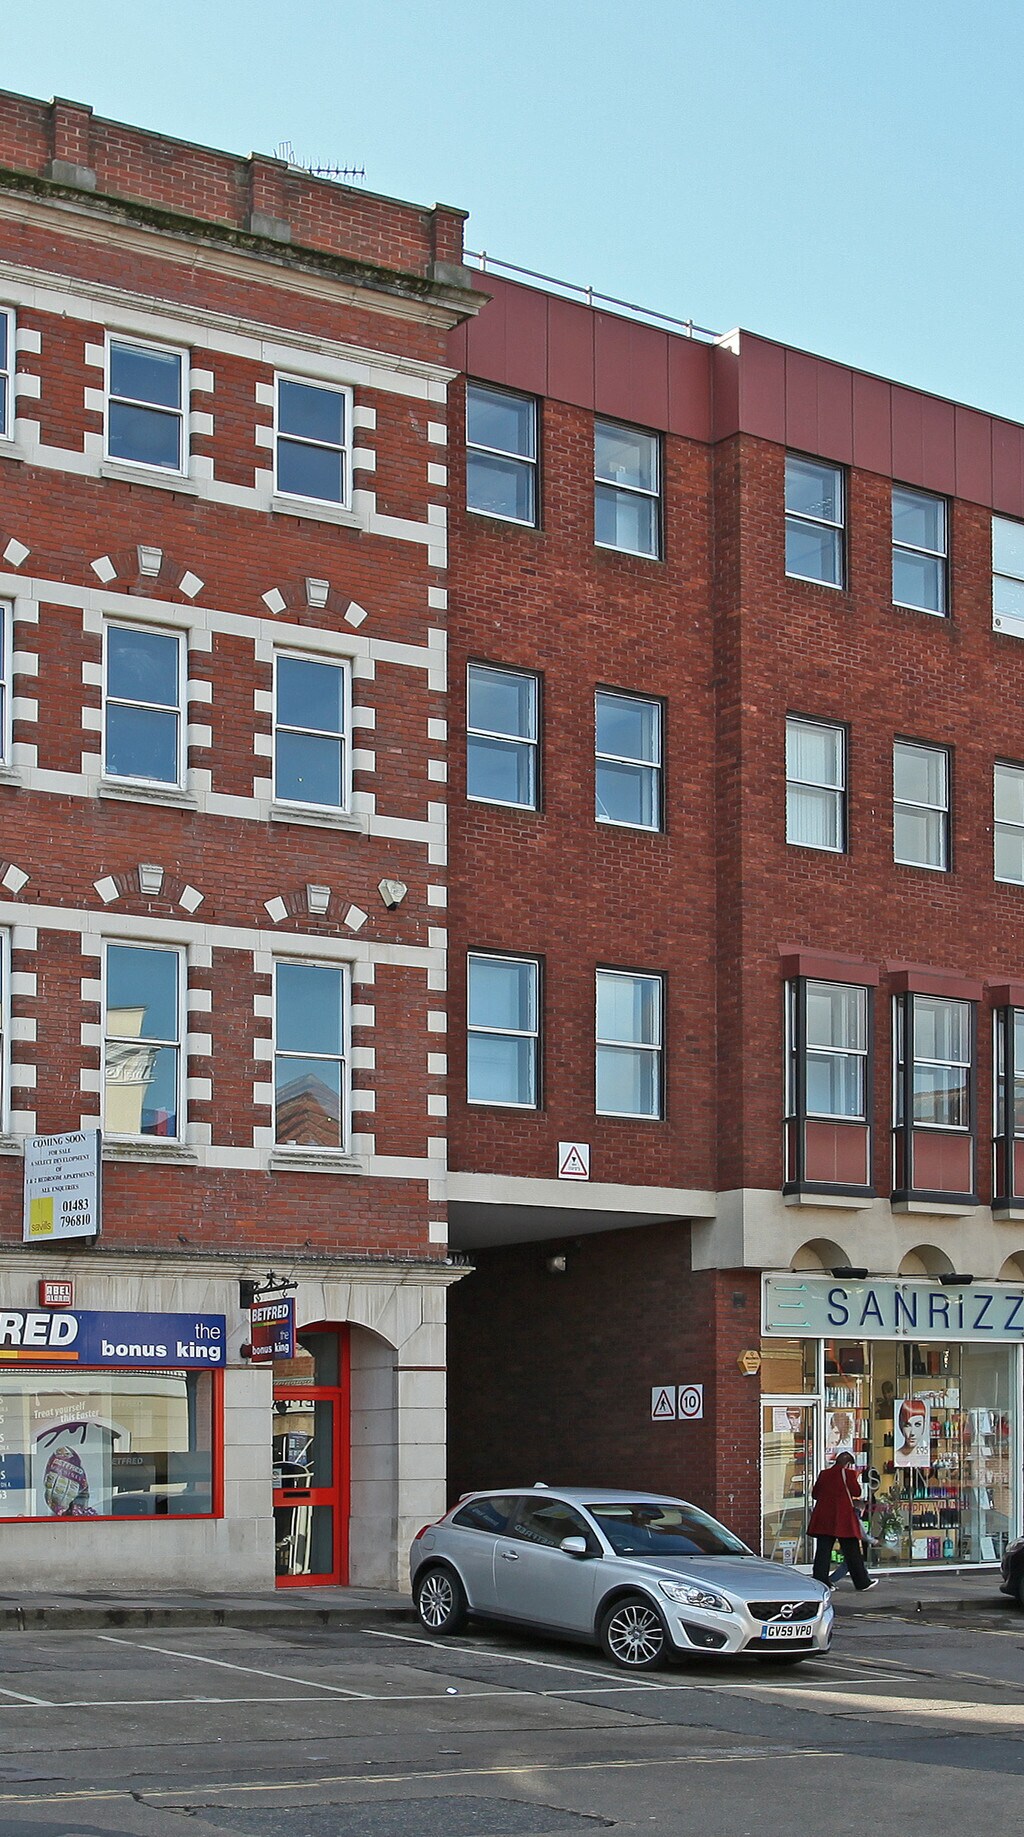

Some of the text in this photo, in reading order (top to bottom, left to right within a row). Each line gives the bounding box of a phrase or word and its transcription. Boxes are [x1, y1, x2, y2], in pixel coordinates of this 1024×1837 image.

[32, 1133, 86, 1149] COMING SOON
[53, 1154, 89, 1164] DEVELOPMENT
[63, 1171, 95, 1180] APARTMENTS
[62, 1198, 89, 1212] 01483
[31, 1221, 52, 1232] savills
[60, 1214, 91, 1228] 796810
[46, 1286, 70, 1295] ABEL
[252, 1304, 289, 1322] BETFRED
[827, 1288, 1024, 1331] SANRIZZ
[195, 1323, 221, 1339] the
[101, 1340, 221, 1361] bonus king
[252, 1342, 290, 1355] bonus king
[684, 1395, 697, 1408] 10
[34, 1401, 86, 1419] Treat yourself
[60, 1410, 100, 1422] this Easter
[916, 1446, 928, 1455] £95
[768, 1627, 793, 1637] GV59
